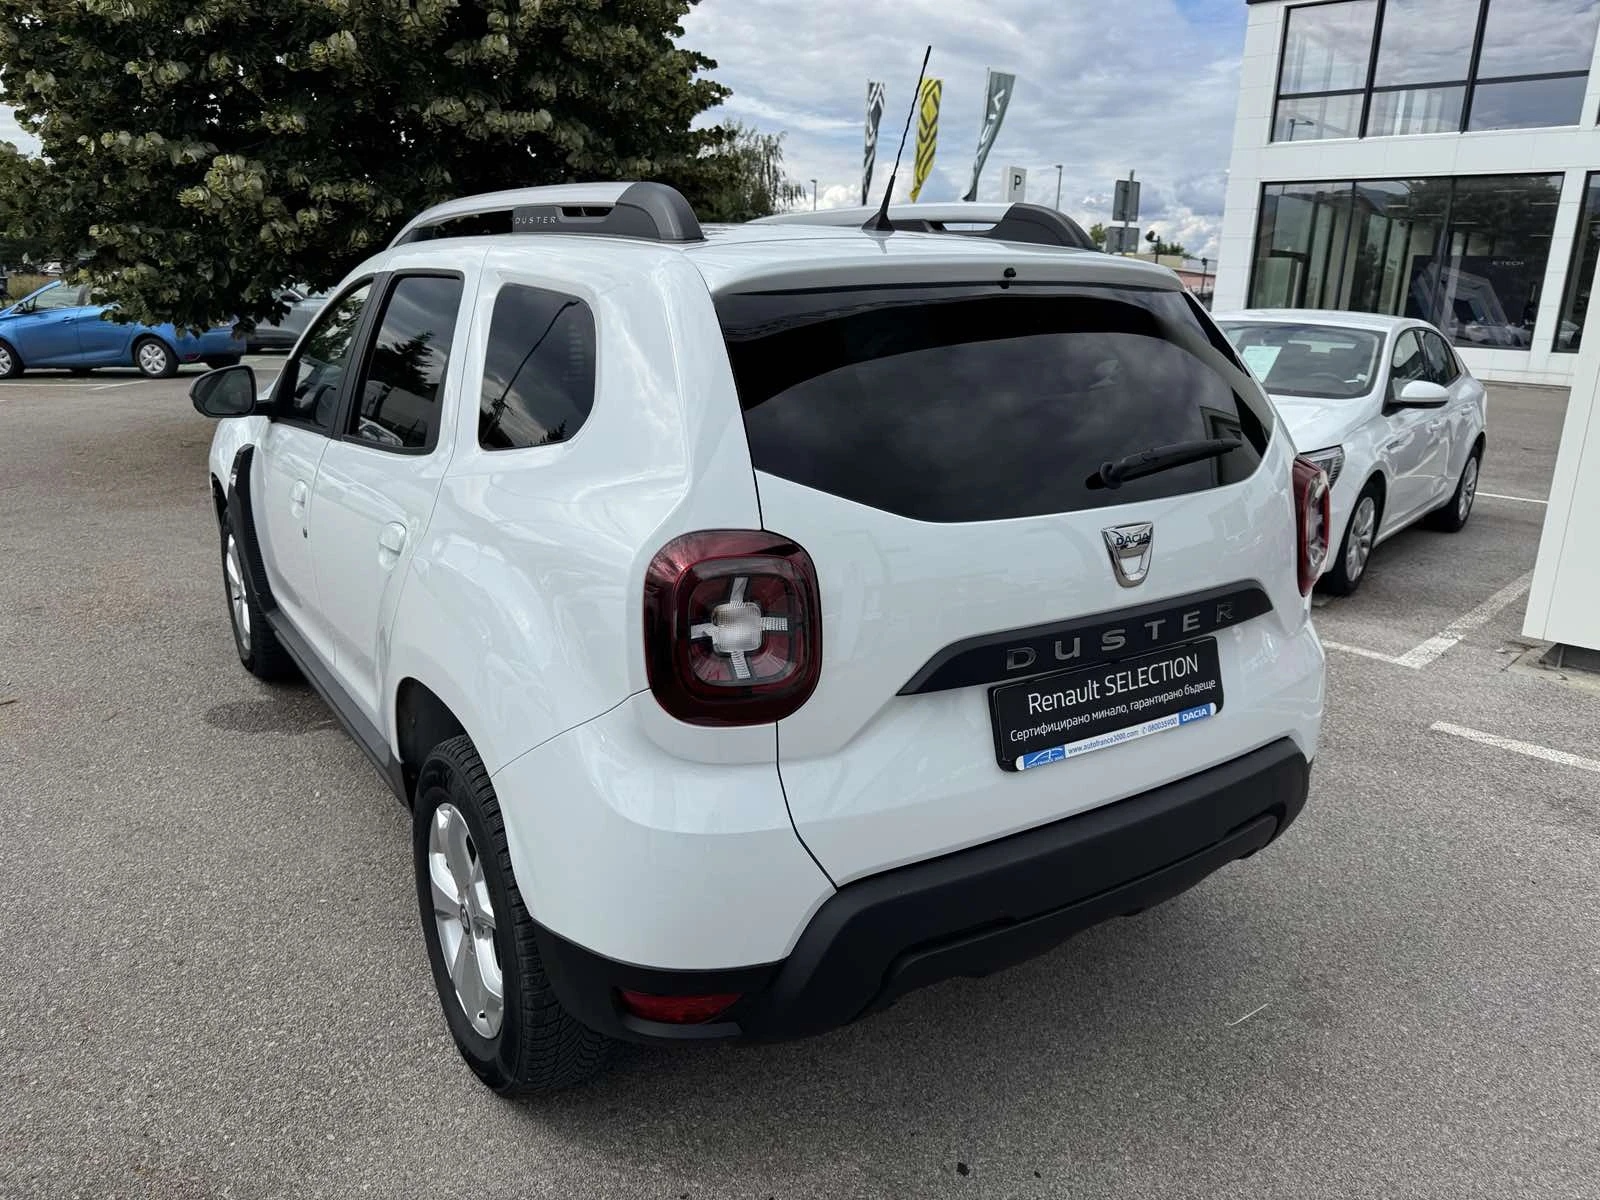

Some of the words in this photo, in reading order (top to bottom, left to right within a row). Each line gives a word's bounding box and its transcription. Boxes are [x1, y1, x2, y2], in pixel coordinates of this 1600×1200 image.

[1013, 174, 1022, 191] P
[514, 215, 556, 225] DUSTER
[1116, 532, 1150, 546] DACIA
[1005, 601, 1234, 670] DUSTER
[1027, 679, 1100, 714] Renault
[1105, 653, 1199, 696] SELECTION
[1010, 714, 1091, 742] Сертифицирано
[1091, 704, 1129, 721] минало,
[1130, 688, 1183, 711] гарантирано
[1184, 679, 1216, 696] бъдеще
[1182, 708, 1208, 722] DACIA
